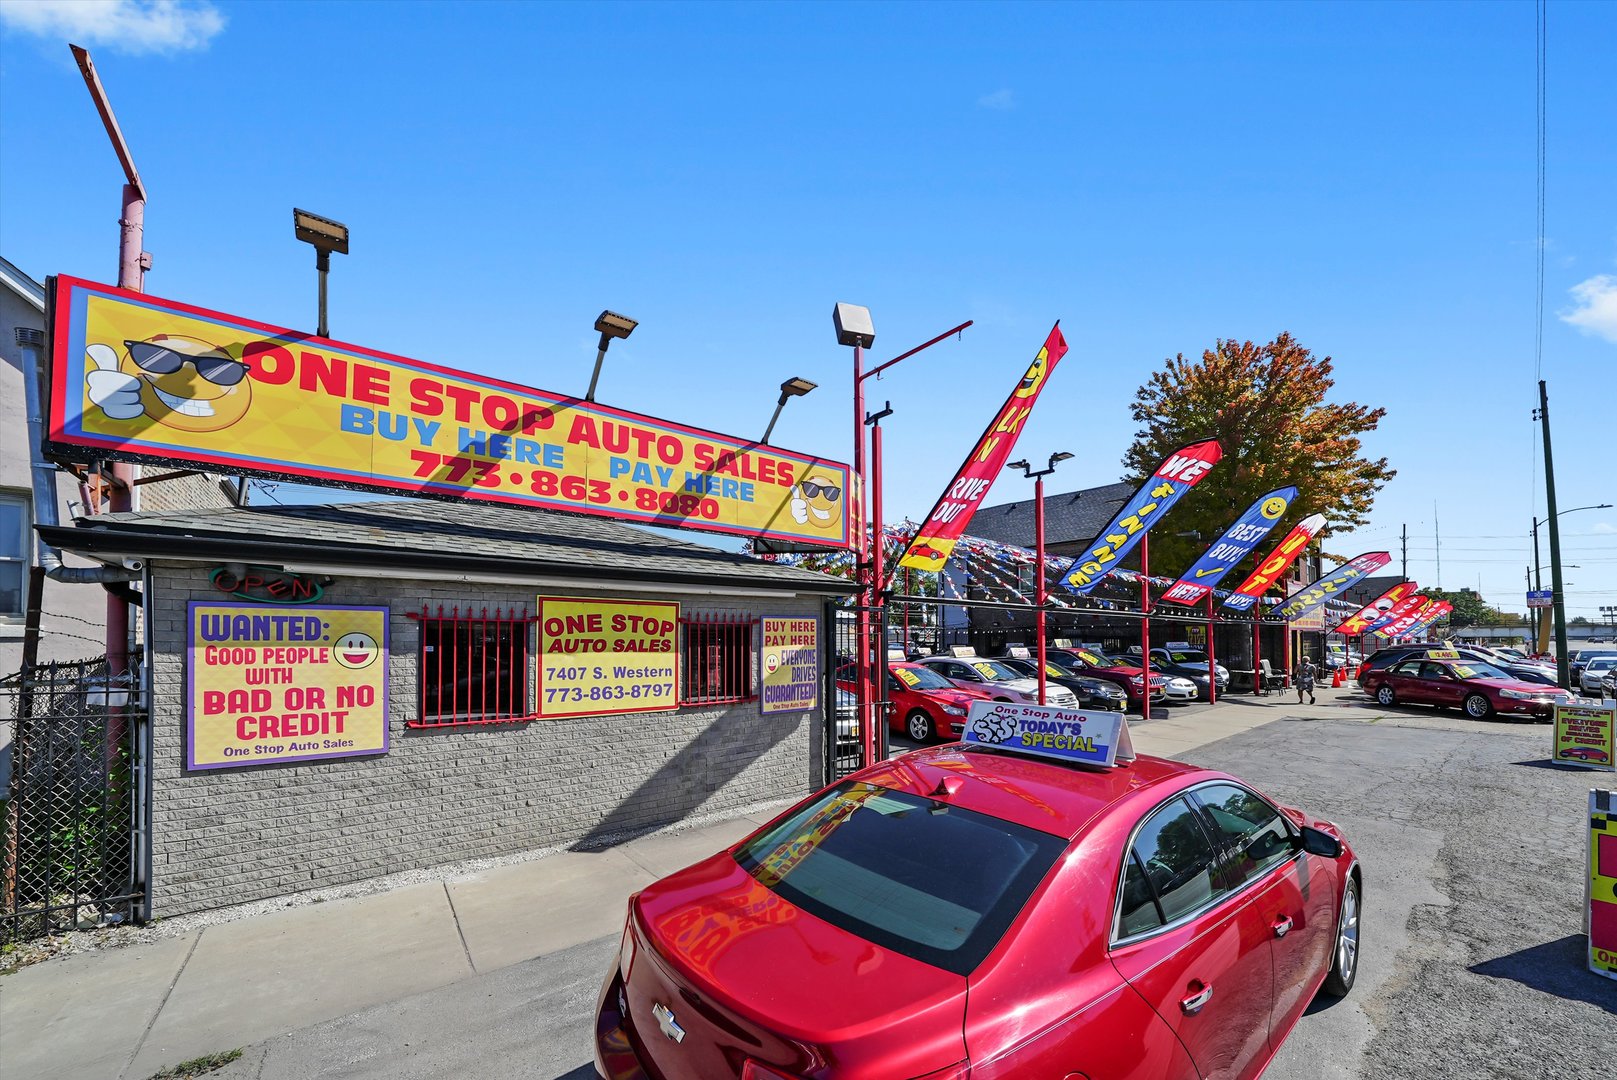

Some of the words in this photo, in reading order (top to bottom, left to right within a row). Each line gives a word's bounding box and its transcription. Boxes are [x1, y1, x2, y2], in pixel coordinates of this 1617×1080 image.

[242, 341, 391, 407] ONE
[409, 378, 555, 436] STOP
[566, 414, 684, 465] AUTO
[693, 443, 795, 488] SALES
[340, 403, 441, 447] BUY
[457, 426, 564, 469] HERE
[609, 456, 674, 488] PAY
[684, 470, 755, 503] HERE
[1158, 454, 1214, 482] WE
[931, 501, 967, 524] OUT
[1067, 482, 1176, 588] FINANCE
[1227, 523, 1271, 543] BEST
[1208, 543, 1250, 562] BUYS
[214, 574, 312, 598] OPEN
[1166, 583, 1210, 602] HERE
[1280, 569, 1361, 617] FINANCE
[1224, 595, 1254, 607] BUYS
[200, 614, 331, 642] WANTED:
[544, 613, 604, 638] ONE
[610, 613, 675, 638] STOP
[765, 621, 787, 633] BUY
[790, 621, 816, 633] HERE
[547, 638, 608, 654] AUTO
[612, 638, 673, 653] SALES
[765, 635, 787, 647] PAY
[790, 634, 816, 646] HERE
[263, 647, 329, 665] PEOPLE
[781, 649, 817, 666] EVERYONE
[245, 667, 293, 686] WITH
[546, 667, 588, 681] 7407
[592, 666, 608, 680] S.
[613, 665, 673, 679] Western
[791, 666, 817, 683] DRIVES
[203, 688, 272, 716] BAD
[284, 687, 326, 712] OR
[336, 684, 375, 709] NO
[544, 683, 674, 703] 773-863-8797
[765, 682, 817, 704] GUARANTEED!
[994, 705, 1020, 715] One
[1021, 708, 1051, 720] Stop
[1054, 711, 1088, 723] Auto
[1561, 717, 1608, 727] EVERYONE
[235, 711, 350, 741] CREDIT
[1018, 719, 1082, 736] TODAY'S
[223, 746, 251, 758] One
[254, 744, 285, 755] Stop
[288, 741, 320, 752] Auto
[323, 738, 354, 749] Sales
[1020, 732, 1098, 753] SPECIAL
